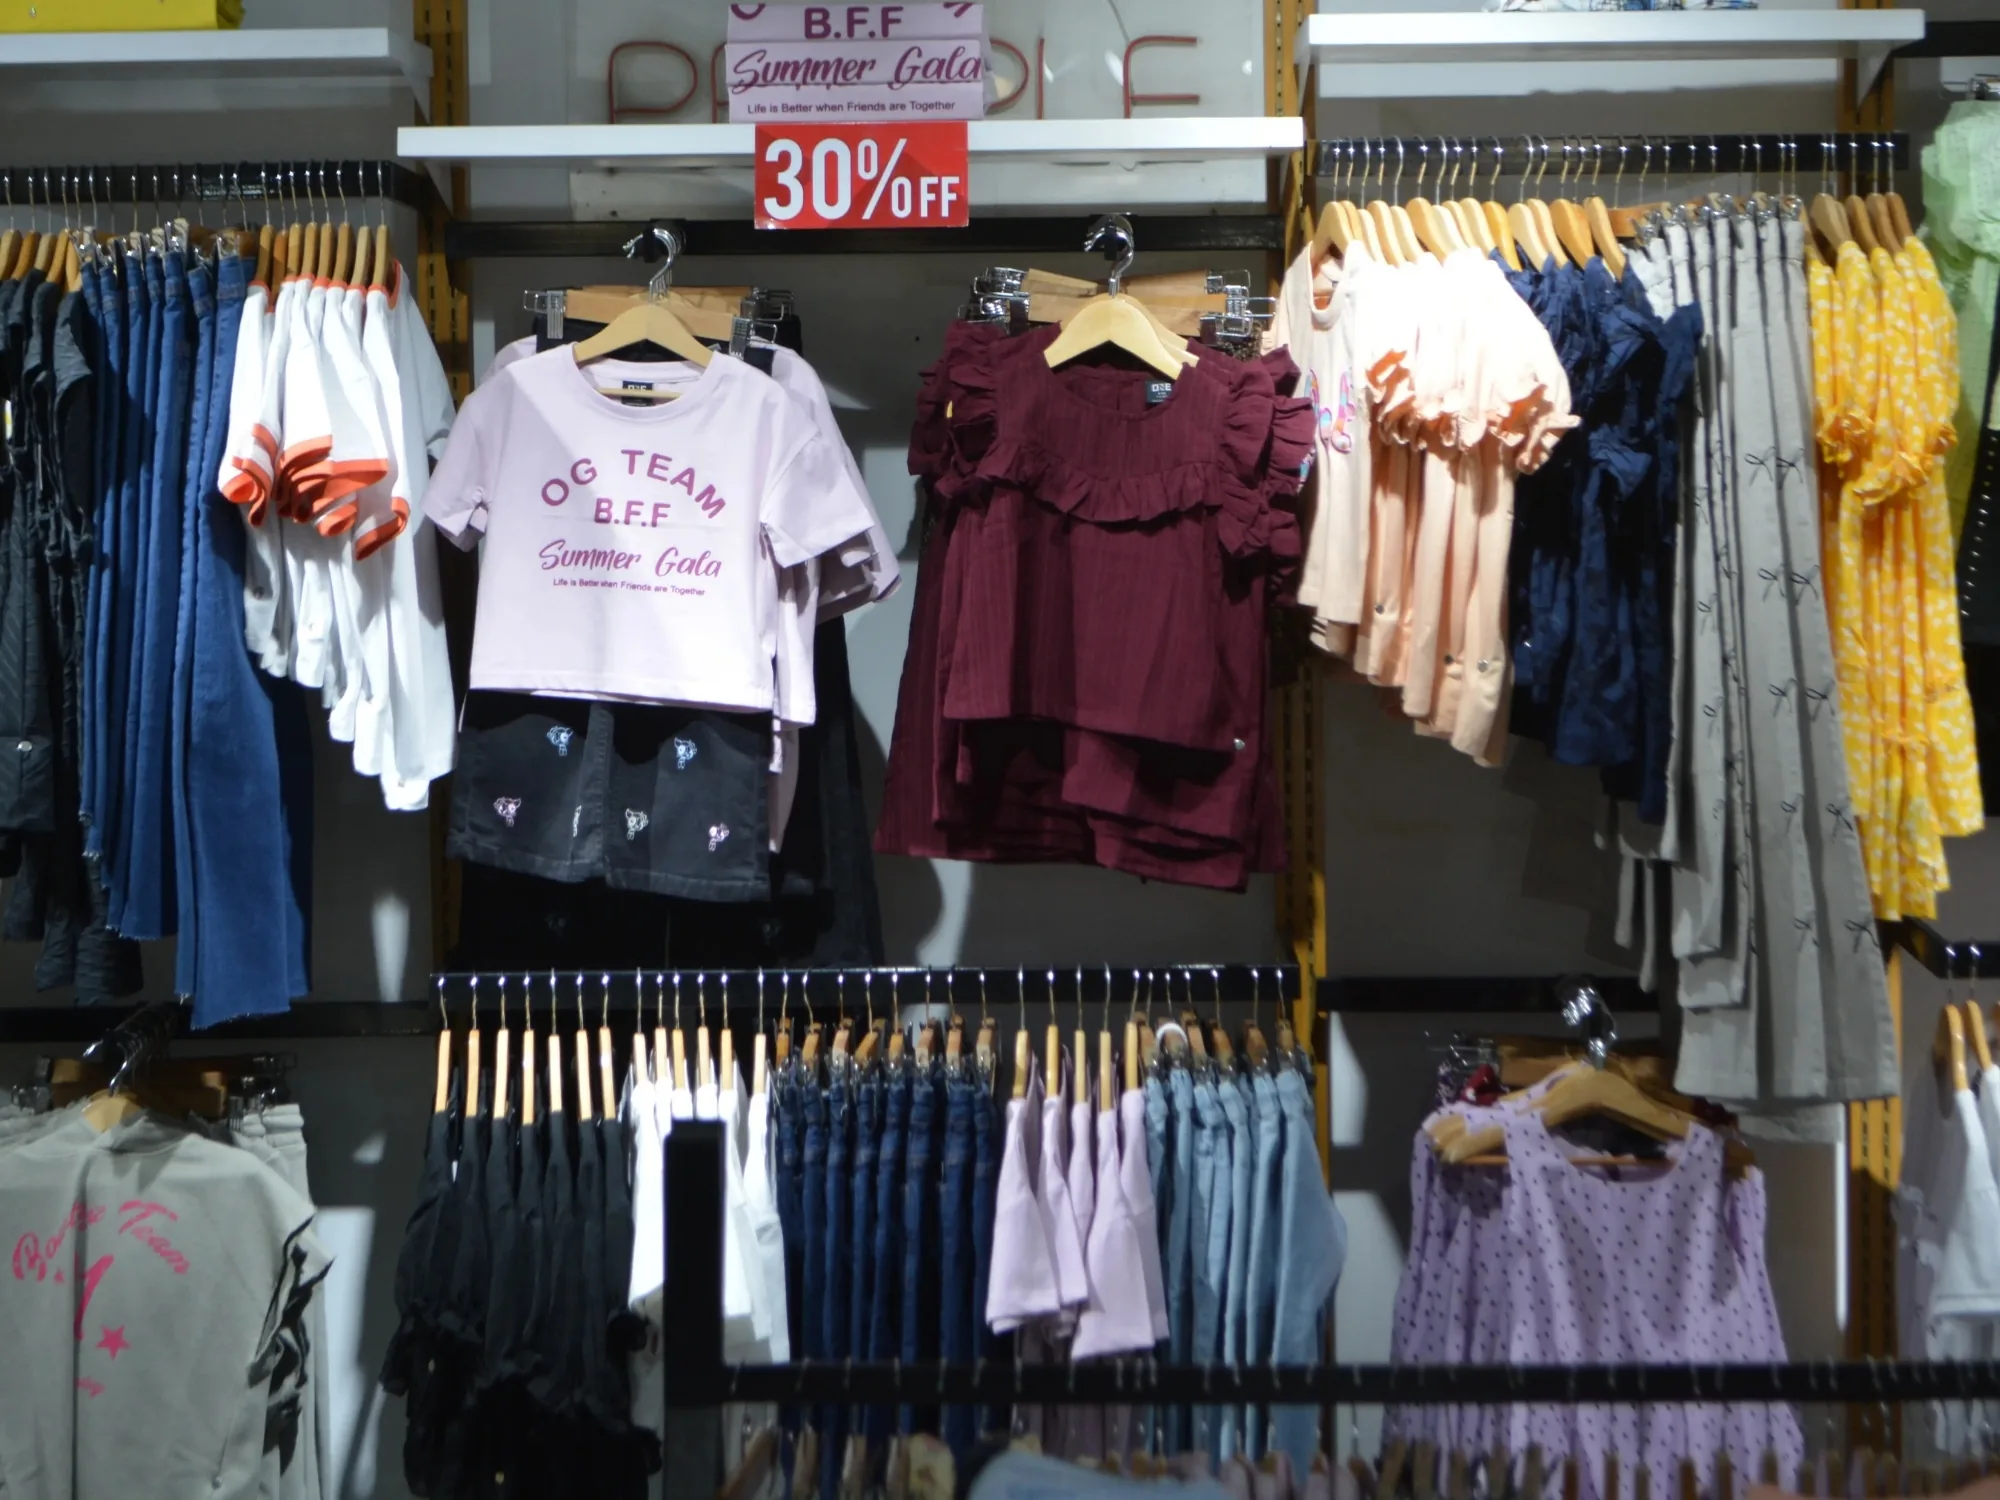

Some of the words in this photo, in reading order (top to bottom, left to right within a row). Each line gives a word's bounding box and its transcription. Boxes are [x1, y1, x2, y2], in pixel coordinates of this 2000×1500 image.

[804, 6, 904, 40] B.F.F
[731, 49, 877, 95] Summer
[887, 45, 983, 91] Gala
[747, 103, 767, 114] Life
[769, 102, 779, 113] is
[781, 102, 813, 114] Better
[815, 102, 844, 113] when
[847, 101, 886, 112] Friends
[889, 101, 906, 111] are
[909, 100, 956, 114] Together
[541, 458, 598, 507] OG
[620, 449, 726, 519] TEAM
[593, 497, 671, 528] B.F.F
[538, 539, 642, 571] Summer
[654, 546, 722, 578] Gala
[553, 577, 568, 587] Life
[570, 578, 577, 586] is
[620, 580, 652, 592] Friends
[654, 585, 668, 593] are
[670, 584, 706, 596] Together
